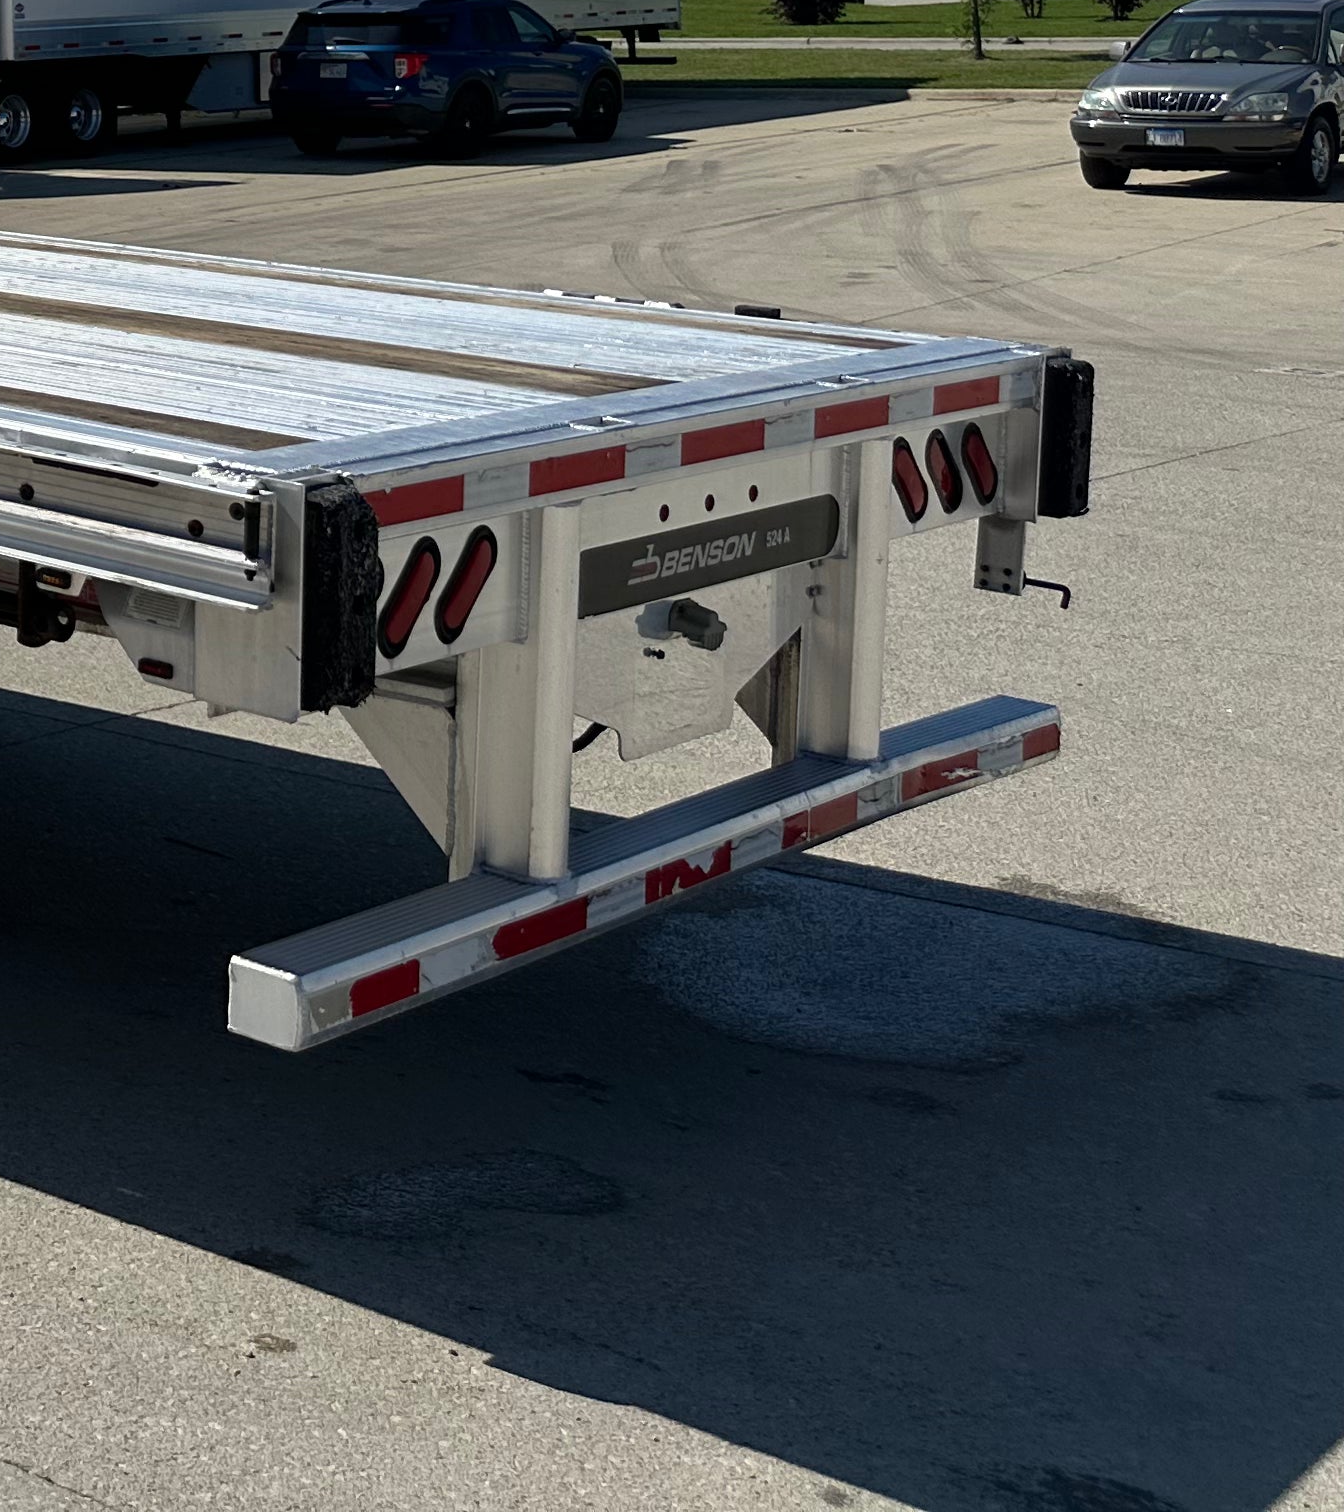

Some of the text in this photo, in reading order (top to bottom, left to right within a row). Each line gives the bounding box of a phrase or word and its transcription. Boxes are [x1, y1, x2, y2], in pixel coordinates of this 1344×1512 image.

[661, 526, 791, 578] BENSON 524 A
